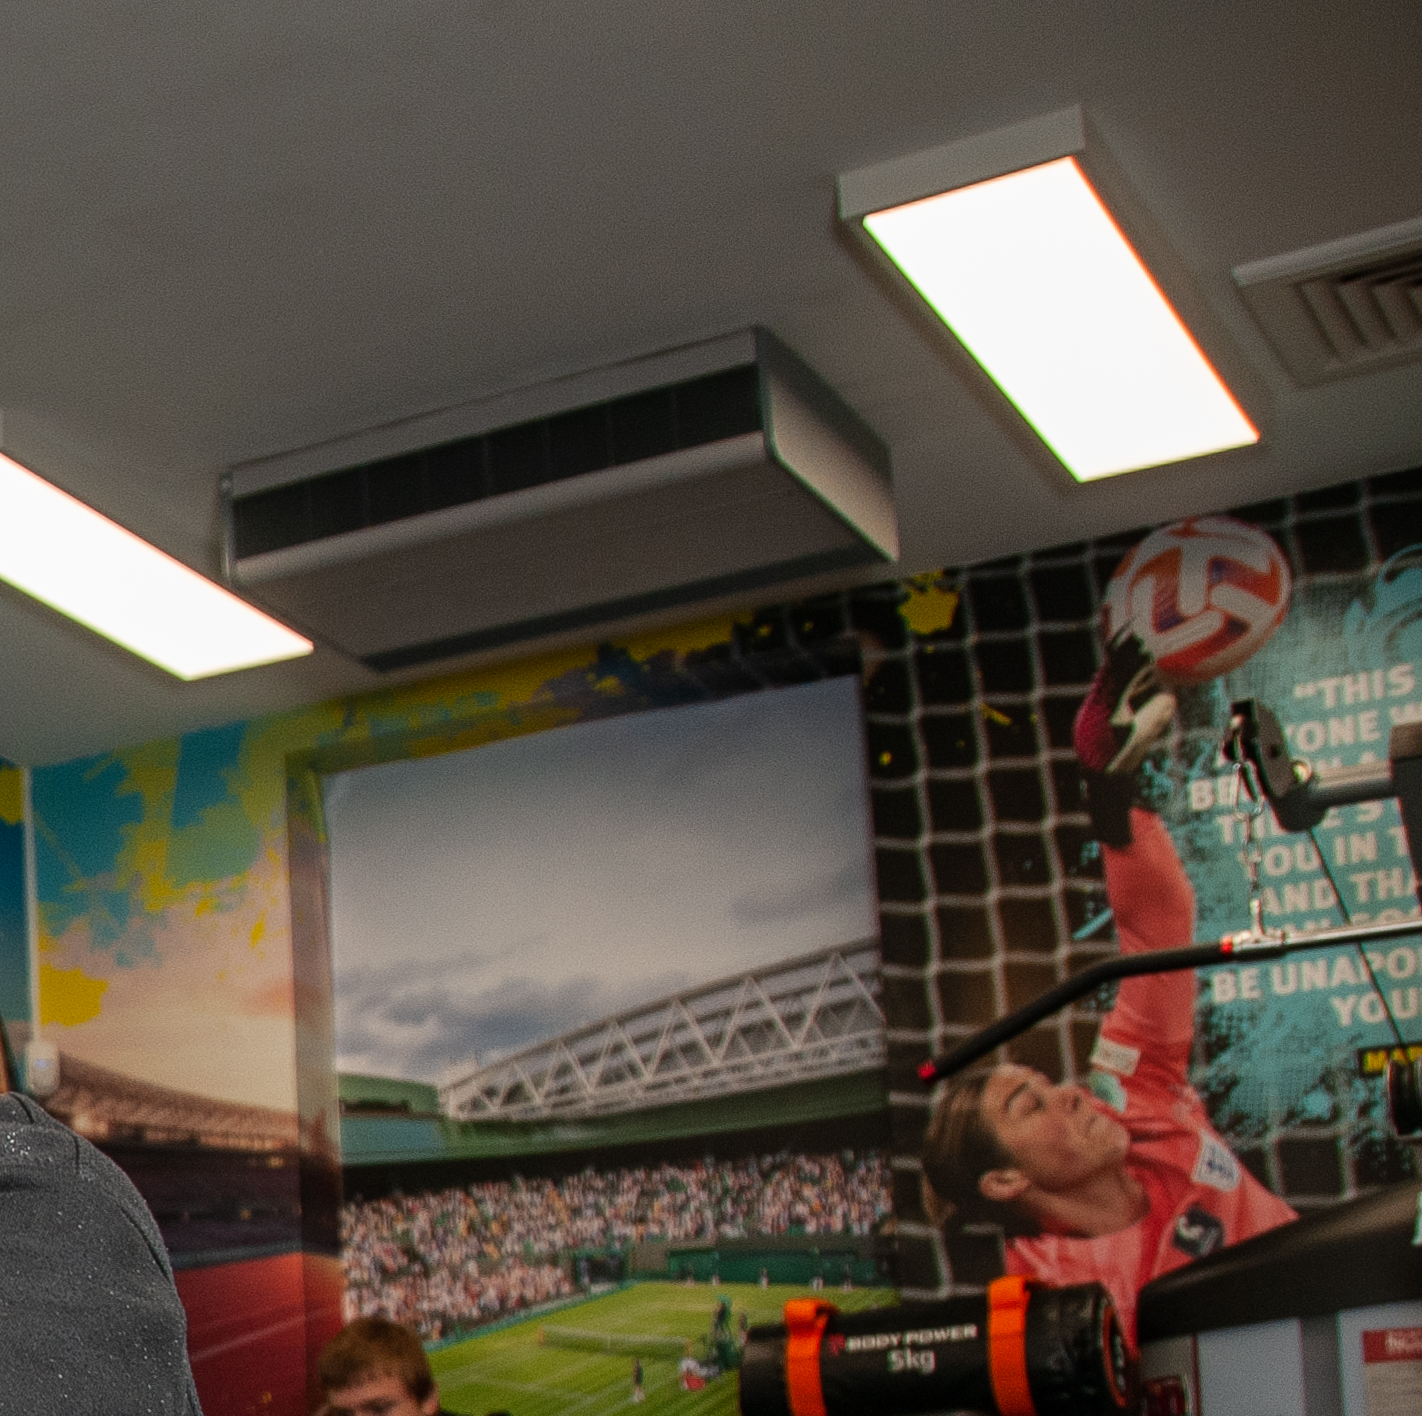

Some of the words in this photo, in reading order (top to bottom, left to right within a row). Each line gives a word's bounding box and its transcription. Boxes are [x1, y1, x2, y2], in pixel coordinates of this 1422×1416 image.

[1286, 709, 1382, 752] ONE
[1335, 830, 1379, 867] IN
[1213, 967, 1265, 1004] BE
[1270, 946, 1422, 996] UNAPO
[846, 1333, 902, 1353] BODY
[903, 1324, 978, 1345] POWER
[888, 1349, 936, 1375] 5kg
